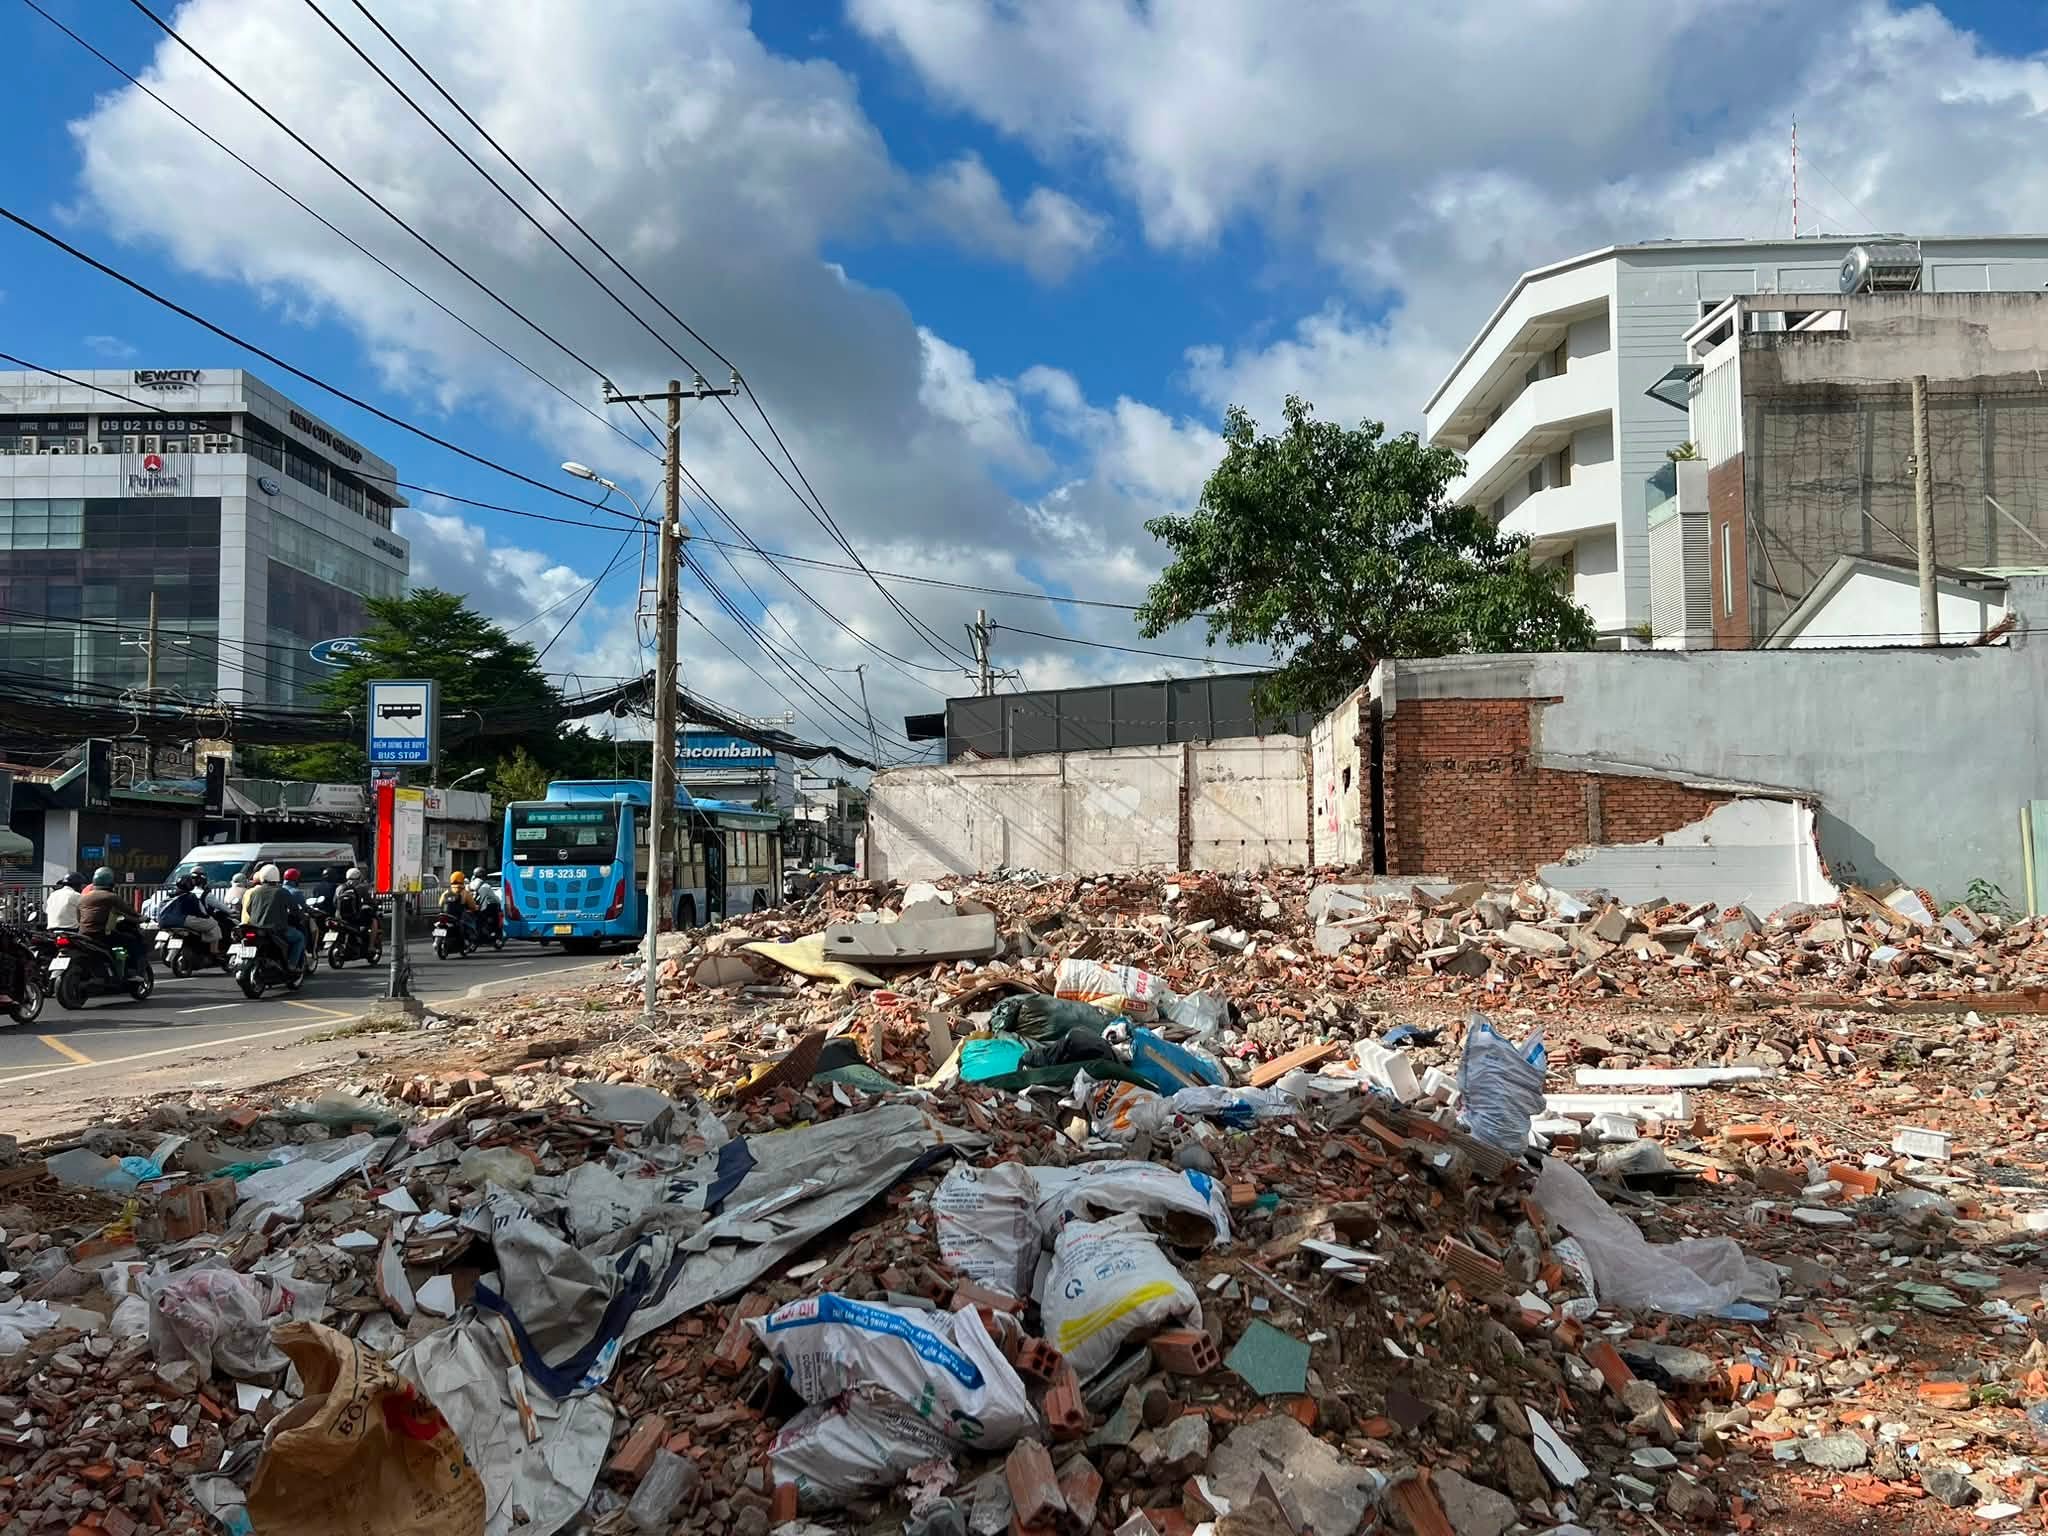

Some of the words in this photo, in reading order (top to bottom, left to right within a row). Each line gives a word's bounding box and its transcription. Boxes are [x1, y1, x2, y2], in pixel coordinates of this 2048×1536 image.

[101, 420, 119, 431] 09
[123, 420, 141, 431] 02
[146, 420, 163, 431] 16
[378, 751, 396, 760] BUS
[397, 751, 421, 760] STOP
[539, 868, 587, 878] 51B-323.50
